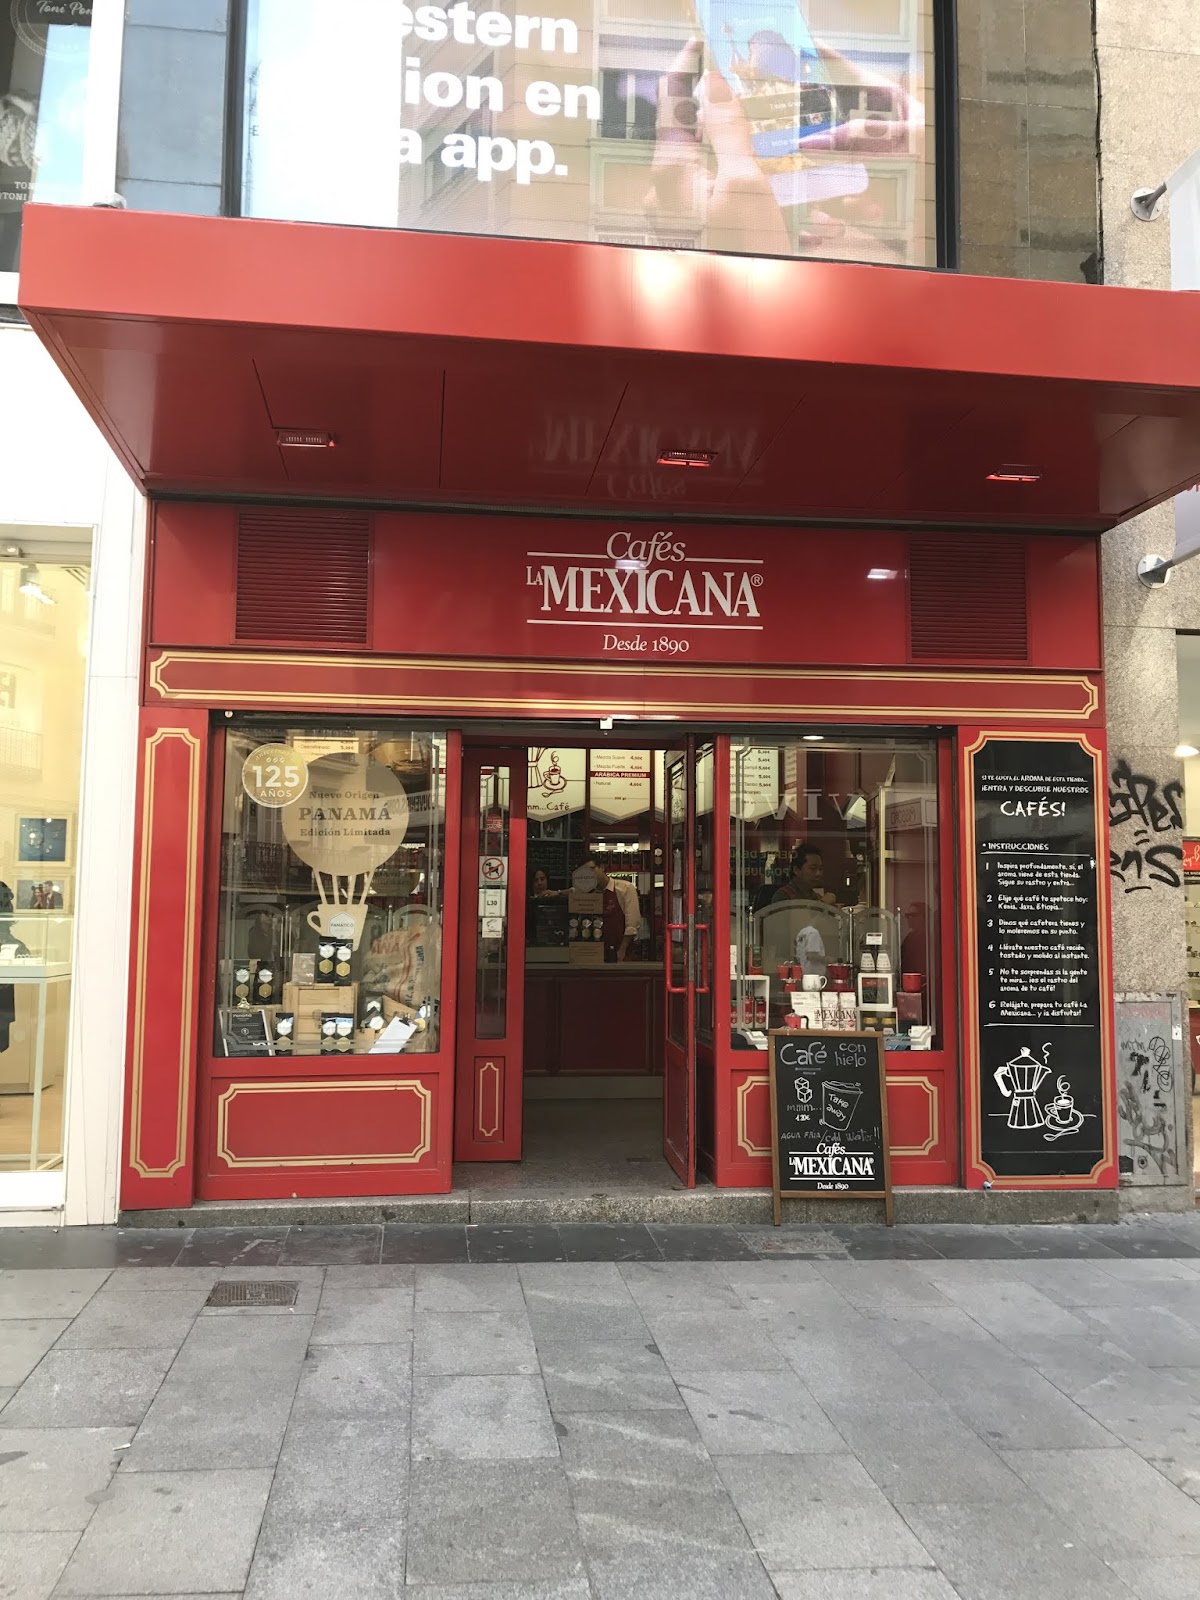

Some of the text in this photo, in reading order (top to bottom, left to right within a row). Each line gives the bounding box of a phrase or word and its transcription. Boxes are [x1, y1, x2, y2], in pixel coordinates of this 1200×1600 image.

[526, 81, 600, 120] en
[441, 133, 568, 184] app.
[606, 531, 686, 568] Cafés
[526, 566, 543, 586] LA
[603, 634, 689, 655] Desde 1890
[252, 765, 300, 788] 125
[260, 789, 292, 798] AÑOS
[309, 791, 380, 800] Nuevo Origen
[298, 804, 392, 820] PANAMÁ
[1000, 796, 1066, 817] CAFÉS!
[300, 827, 390, 836] Edición Limitada
[997, 862, 1018, 870] Inspira
[997, 879, 1015, 887] Sigue
[987, 894, 992, 902] 2
[1013, 894, 1024, 902] qué
[987, 919, 993, 927] 3
[1030, 919, 1058, 927] cafetera
[987, 944, 993, 952] 4
[1069, 969, 1088, 977] gente
[989, 1000, 996, 1008] 6
[780, 1042, 866, 1065] Café con
[835, 1051, 866, 1067] hielo
[828, 1093, 849, 1109] Take
[826, 1104, 847, 1121] away
[781, 1132, 801, 1140] AGUA
[816, 1143, 846, 1157] Cafés
[817, 1182, 849, 1190] Desde 1890
